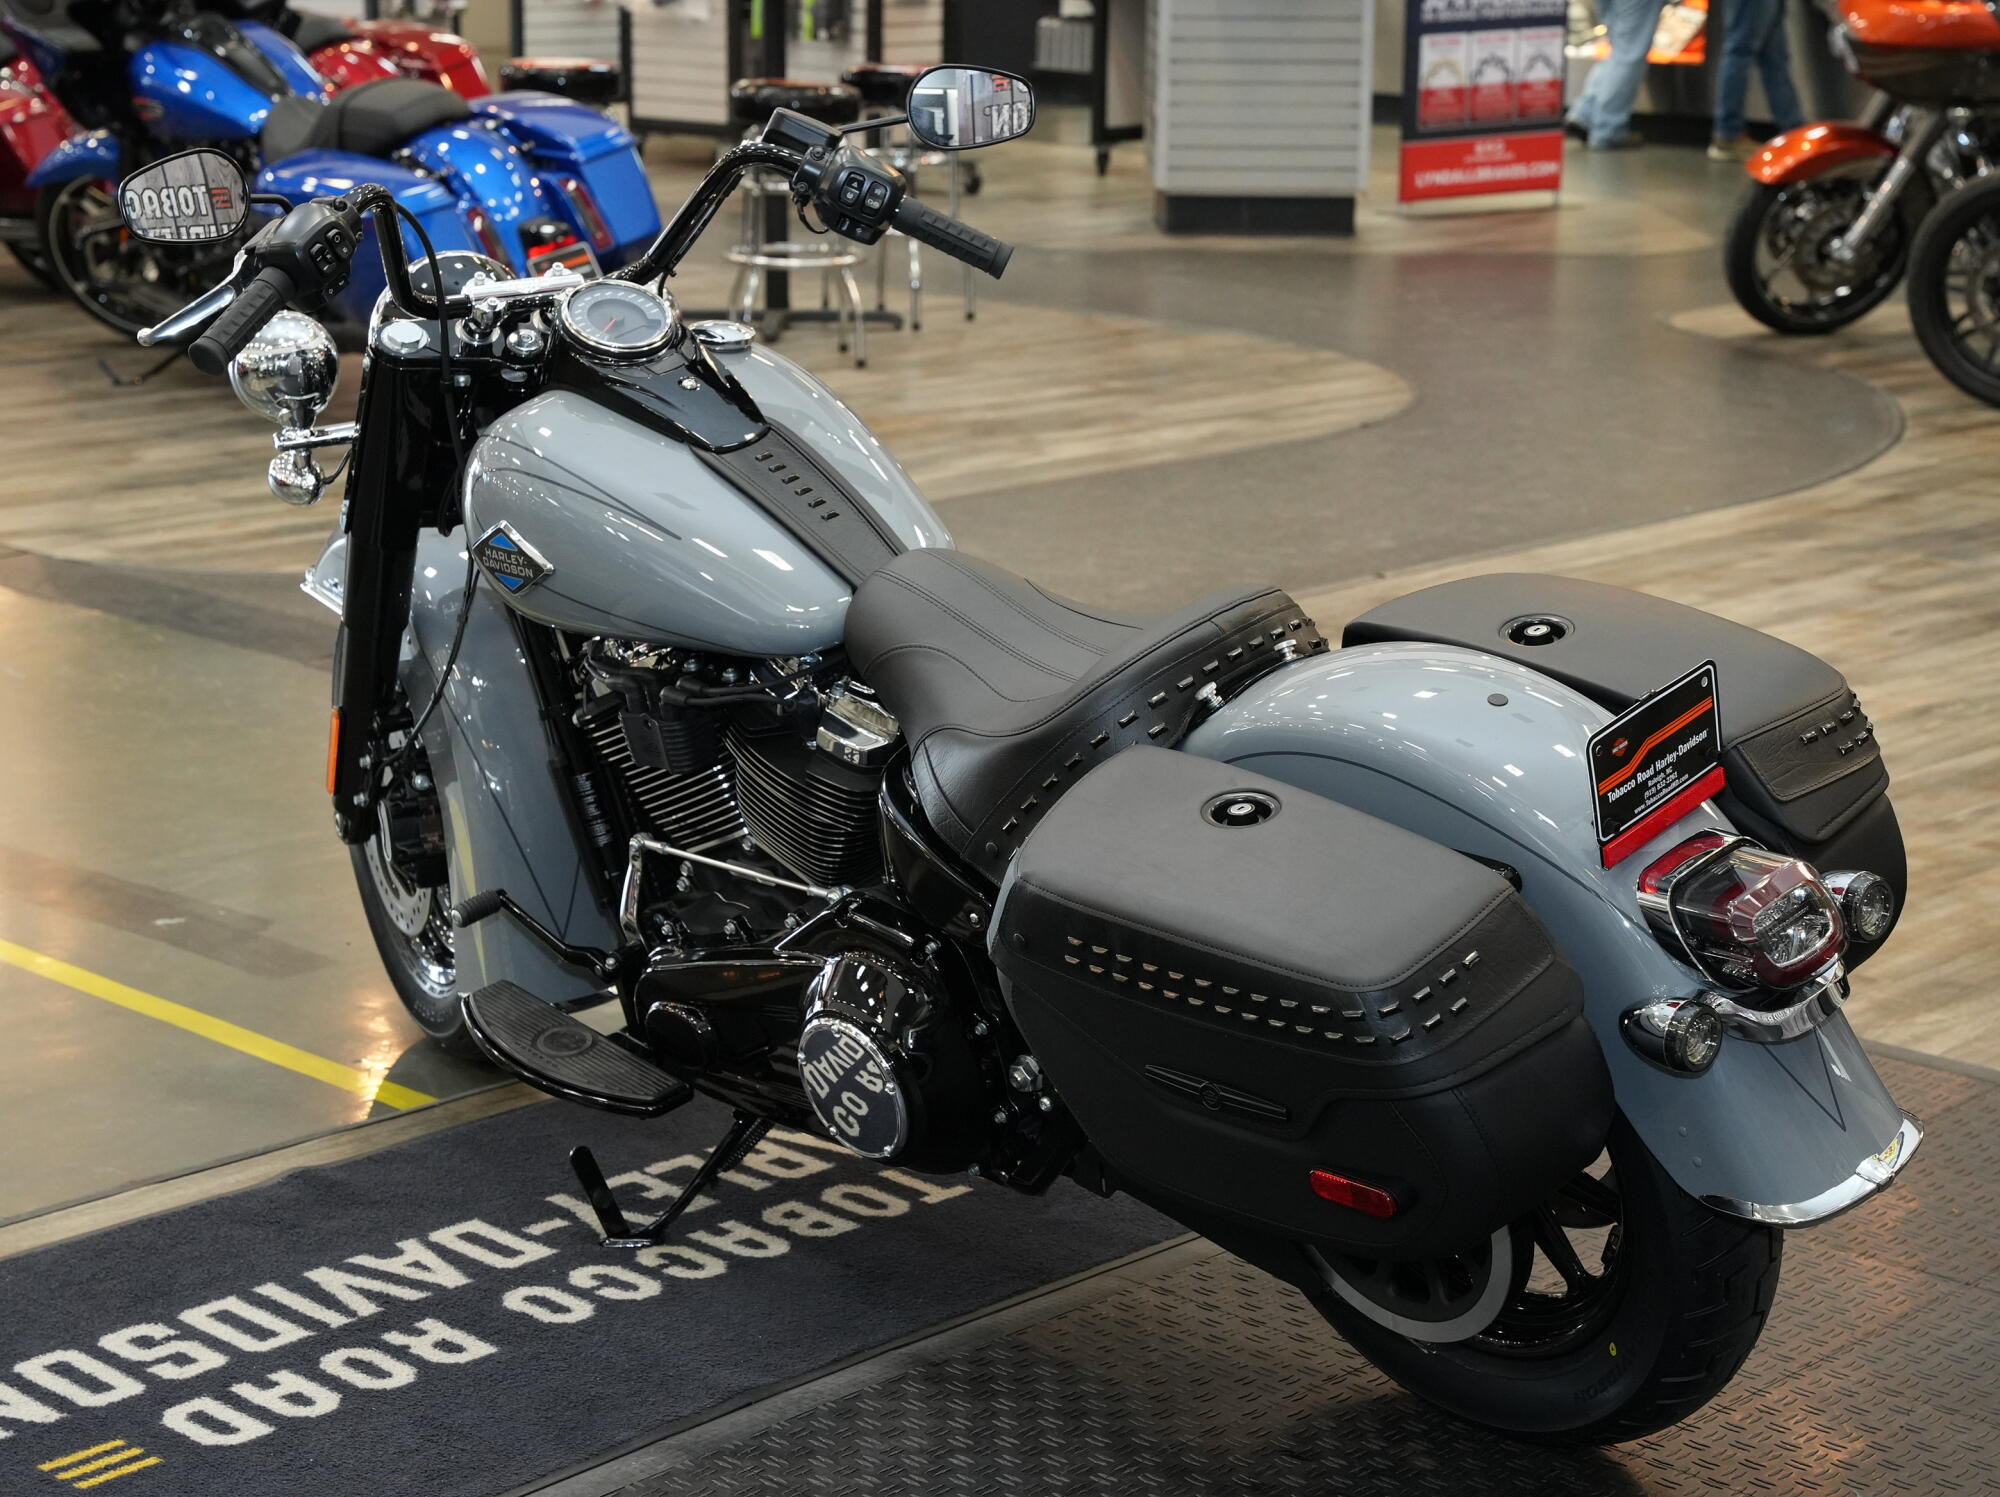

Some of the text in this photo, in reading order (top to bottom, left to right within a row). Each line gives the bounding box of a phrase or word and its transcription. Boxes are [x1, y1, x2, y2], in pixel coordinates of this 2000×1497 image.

[482, 556, 533, 578] DAVIDSON
[484, 547, 527, 567] HARLEY-
[1607, 778, 1636, 803] Tobacco
[1637, 763, 1655, 784] Road
[161, 1169, 974, 1446] TOBACCO ROAD
